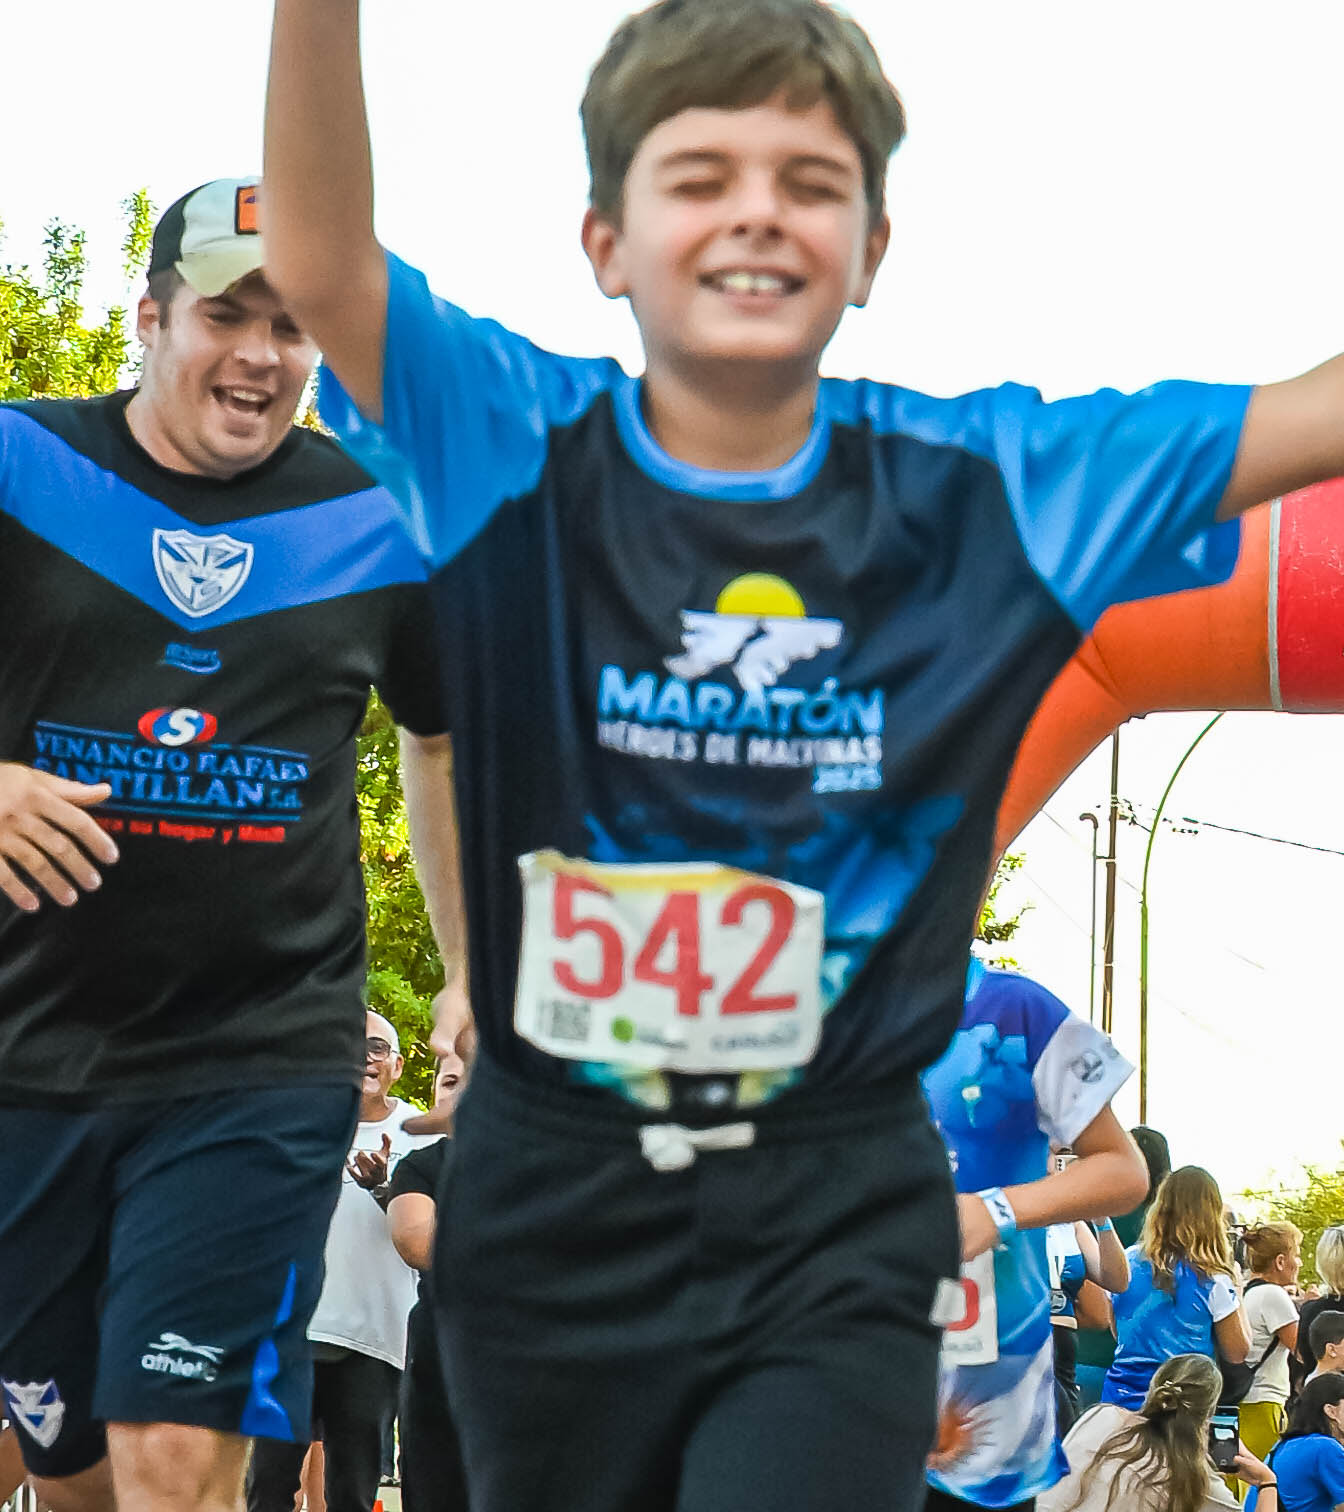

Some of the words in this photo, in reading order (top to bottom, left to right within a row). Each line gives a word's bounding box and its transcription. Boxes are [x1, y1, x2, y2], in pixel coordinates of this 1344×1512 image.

[598, 663, 884, 733] MARATÓN
[34, 731, 190, 772] VENANCIO
[553, 872, 798, 1017] 542
